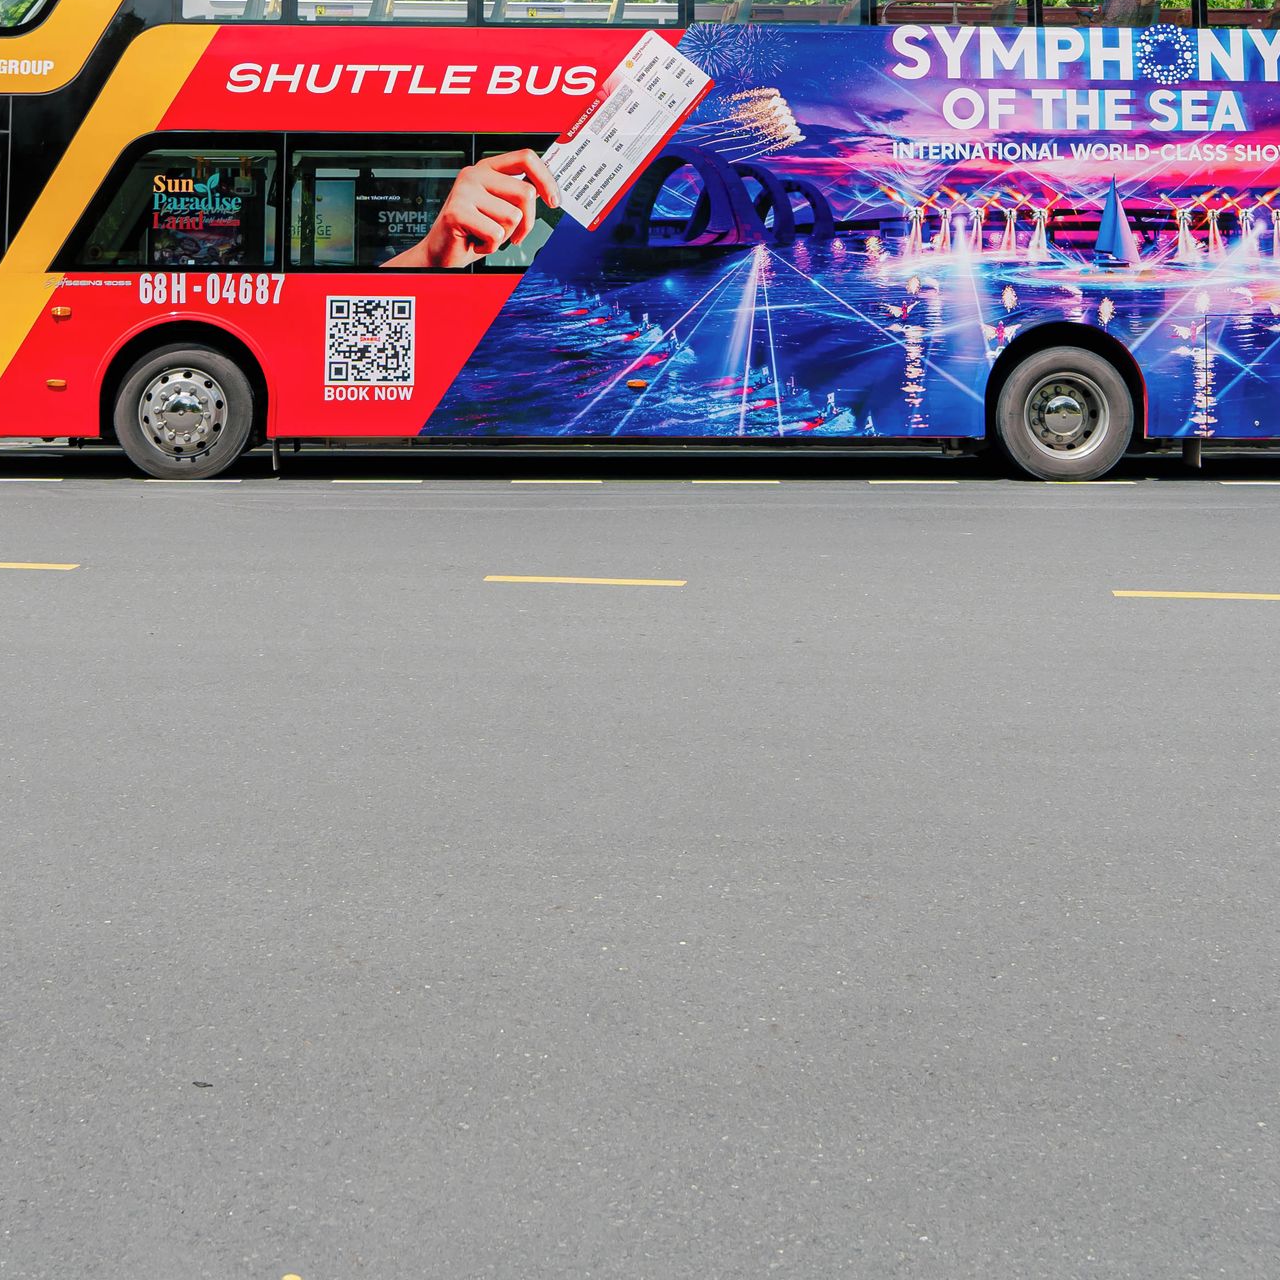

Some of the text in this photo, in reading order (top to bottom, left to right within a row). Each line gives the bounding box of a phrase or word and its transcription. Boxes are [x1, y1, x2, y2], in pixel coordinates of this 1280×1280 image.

[226, 62, 597, 96] SHUTTLE BUS
[636, 55, 659, 82] WOW JOURNEY
[566, 98, 600, 137] BUSINESS CLASS
[943, 87, 1247, 132] OF THE SEA
[559, 155, 576, 174] PHUQUOC
[574, 138, 590, 156] AIRWAYS
[893, 142, 1064, 160] INTERNATIONAL
[1071, 143, 1227, 162] WORLD-CLASS
[153, 175, 195, 193] Sun
[563, 164, 586, 192] WOW JOURNEY
[574, 162, 607, 201] AROUND THE WORLD
[599, 171, 615, 189] TROPICA
[613, 162, 623, 173] FEST
[153, 192, 242, 211] Paradise
[153, 210, 204, 231] Land
[388, 223, 427, 233] OF THE
[324, 386, 414, 401] BOOK NOW
